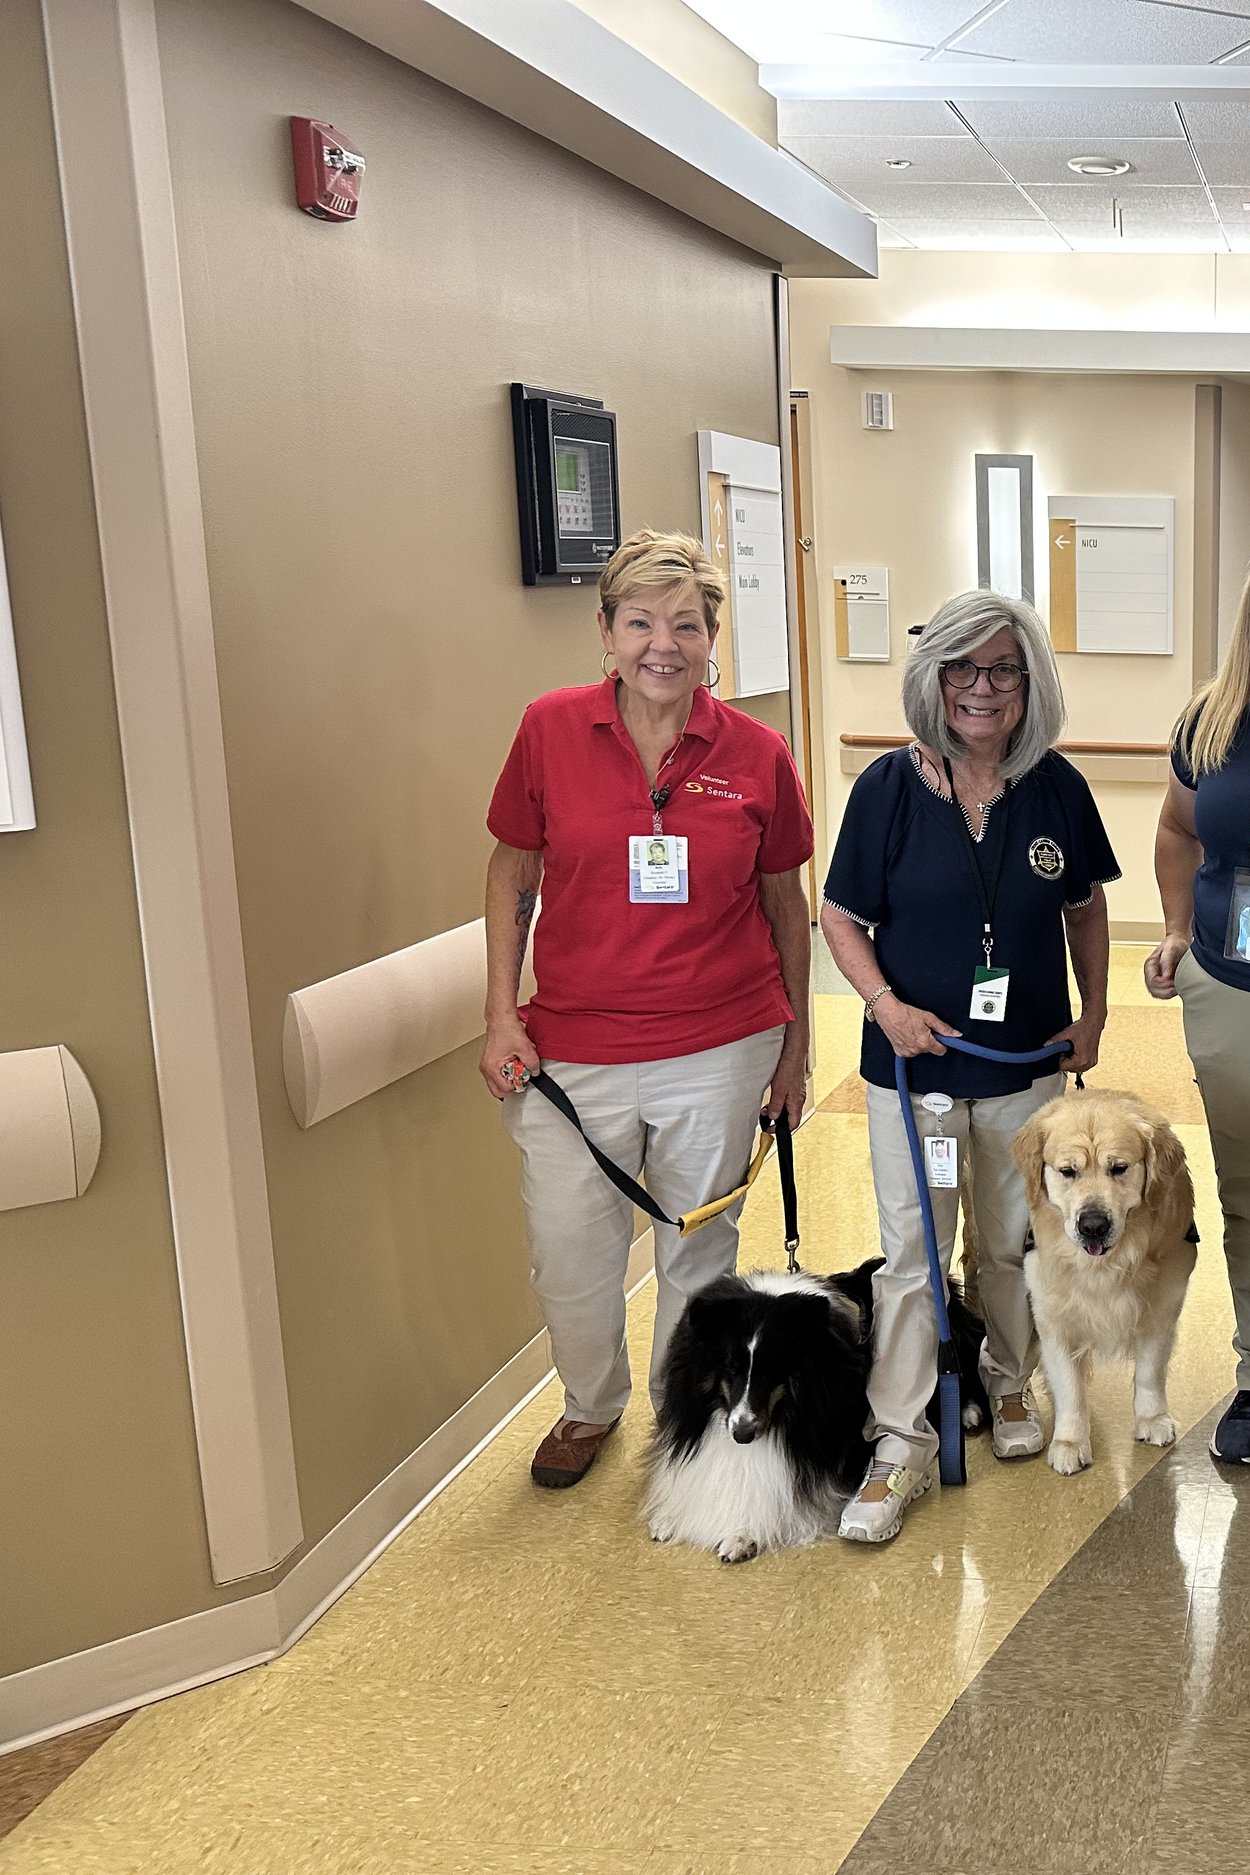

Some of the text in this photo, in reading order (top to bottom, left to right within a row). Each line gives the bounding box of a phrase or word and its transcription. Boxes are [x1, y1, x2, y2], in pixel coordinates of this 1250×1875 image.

[1081, 539, 1098, 548] NICU
[850, 574, 868, 585] 275
[699, 773, 730, 785] Volunteer
[706, 786, 743, 800] Sentara
